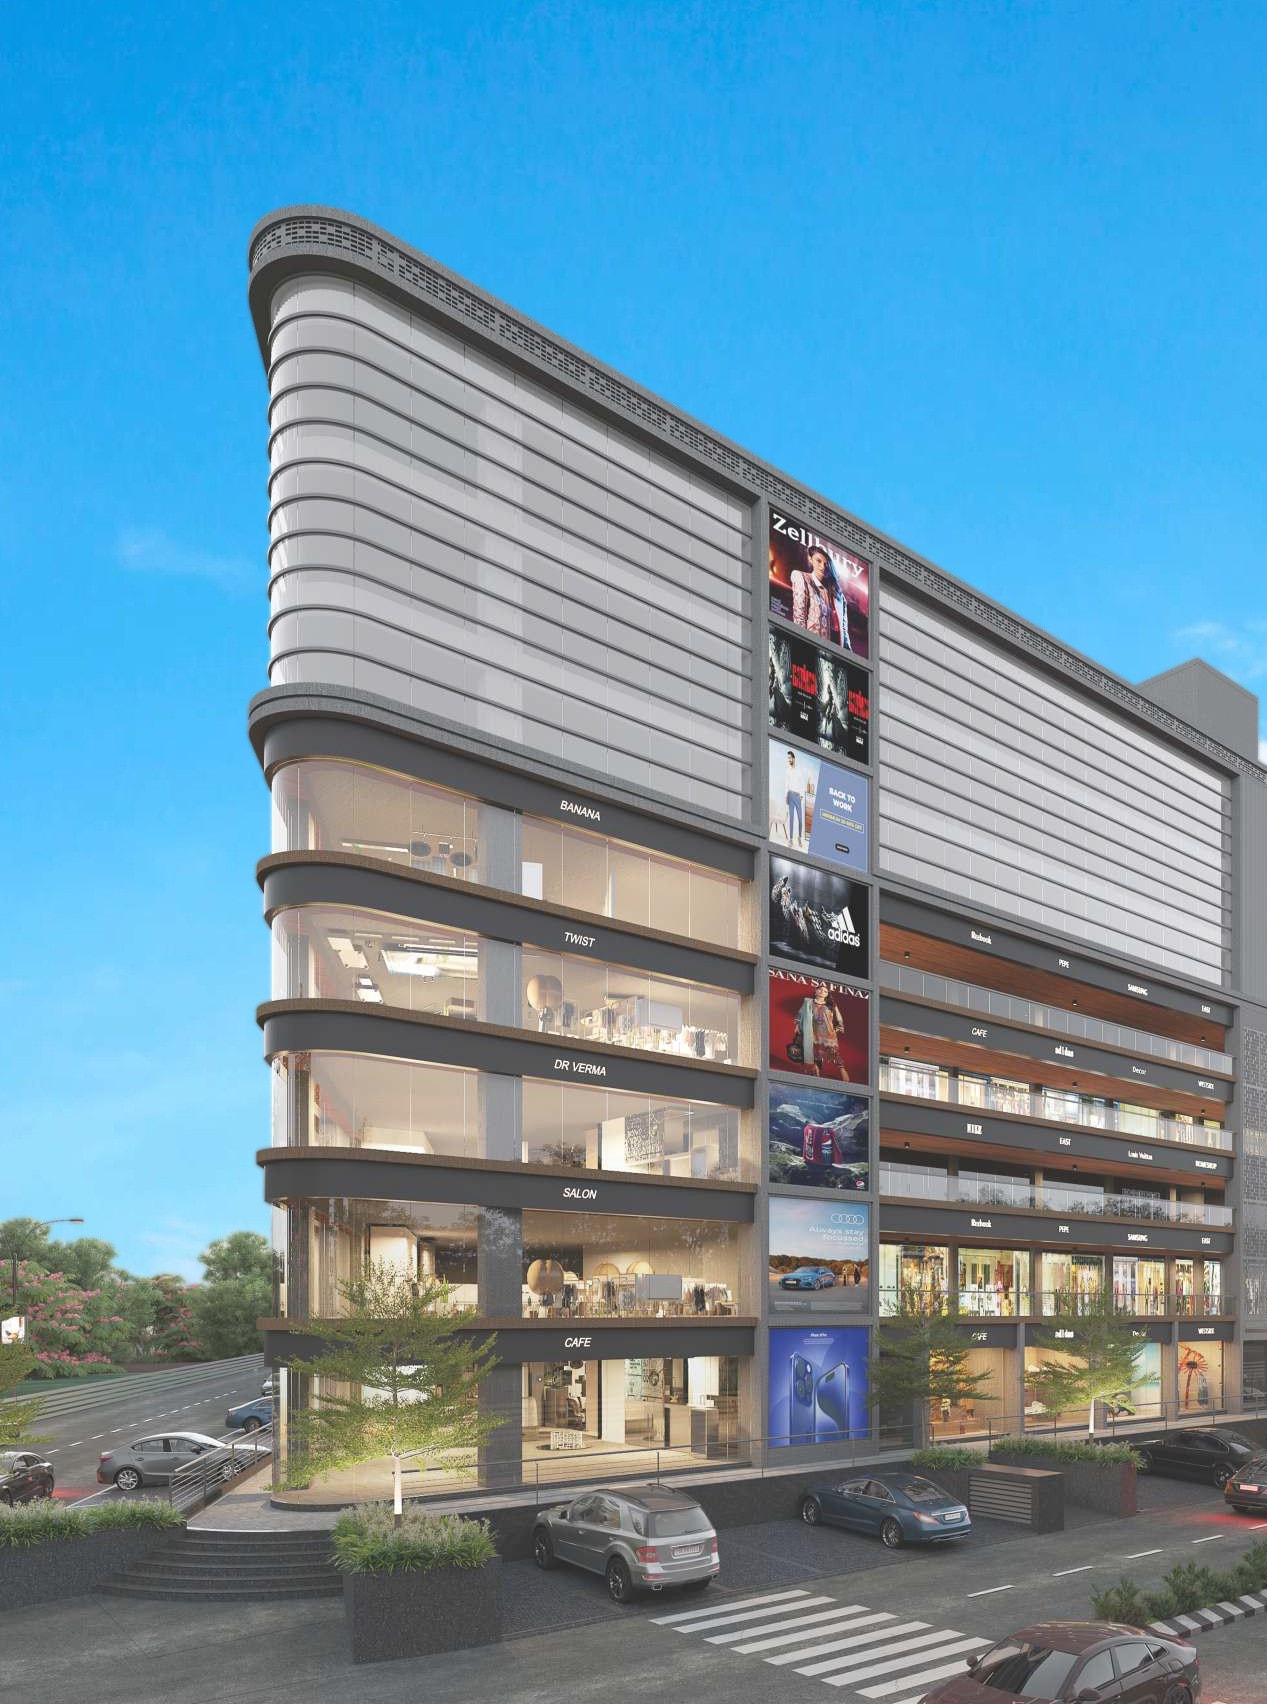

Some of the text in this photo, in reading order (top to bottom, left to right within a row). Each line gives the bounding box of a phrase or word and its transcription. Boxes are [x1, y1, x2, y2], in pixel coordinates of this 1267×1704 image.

[829, 787, 856, 804] BACK TO
[560, 800, 601, 822] BANANA
[832, 798, 853, 813] WORK
[564, 931, 596, 948] TWIST
[828, 928, 861, 948] adidas
[768, 968, 809, 985] SANA
[971, 1028, 988, 1038] CAFE
[554, 1059, 606, 1077] DR VERMA
[1059, 1137, 1071, 1146] EAST
[563, 1187, 598, 1200] SALON
[564, 1337, 592, 1348] CAFE
